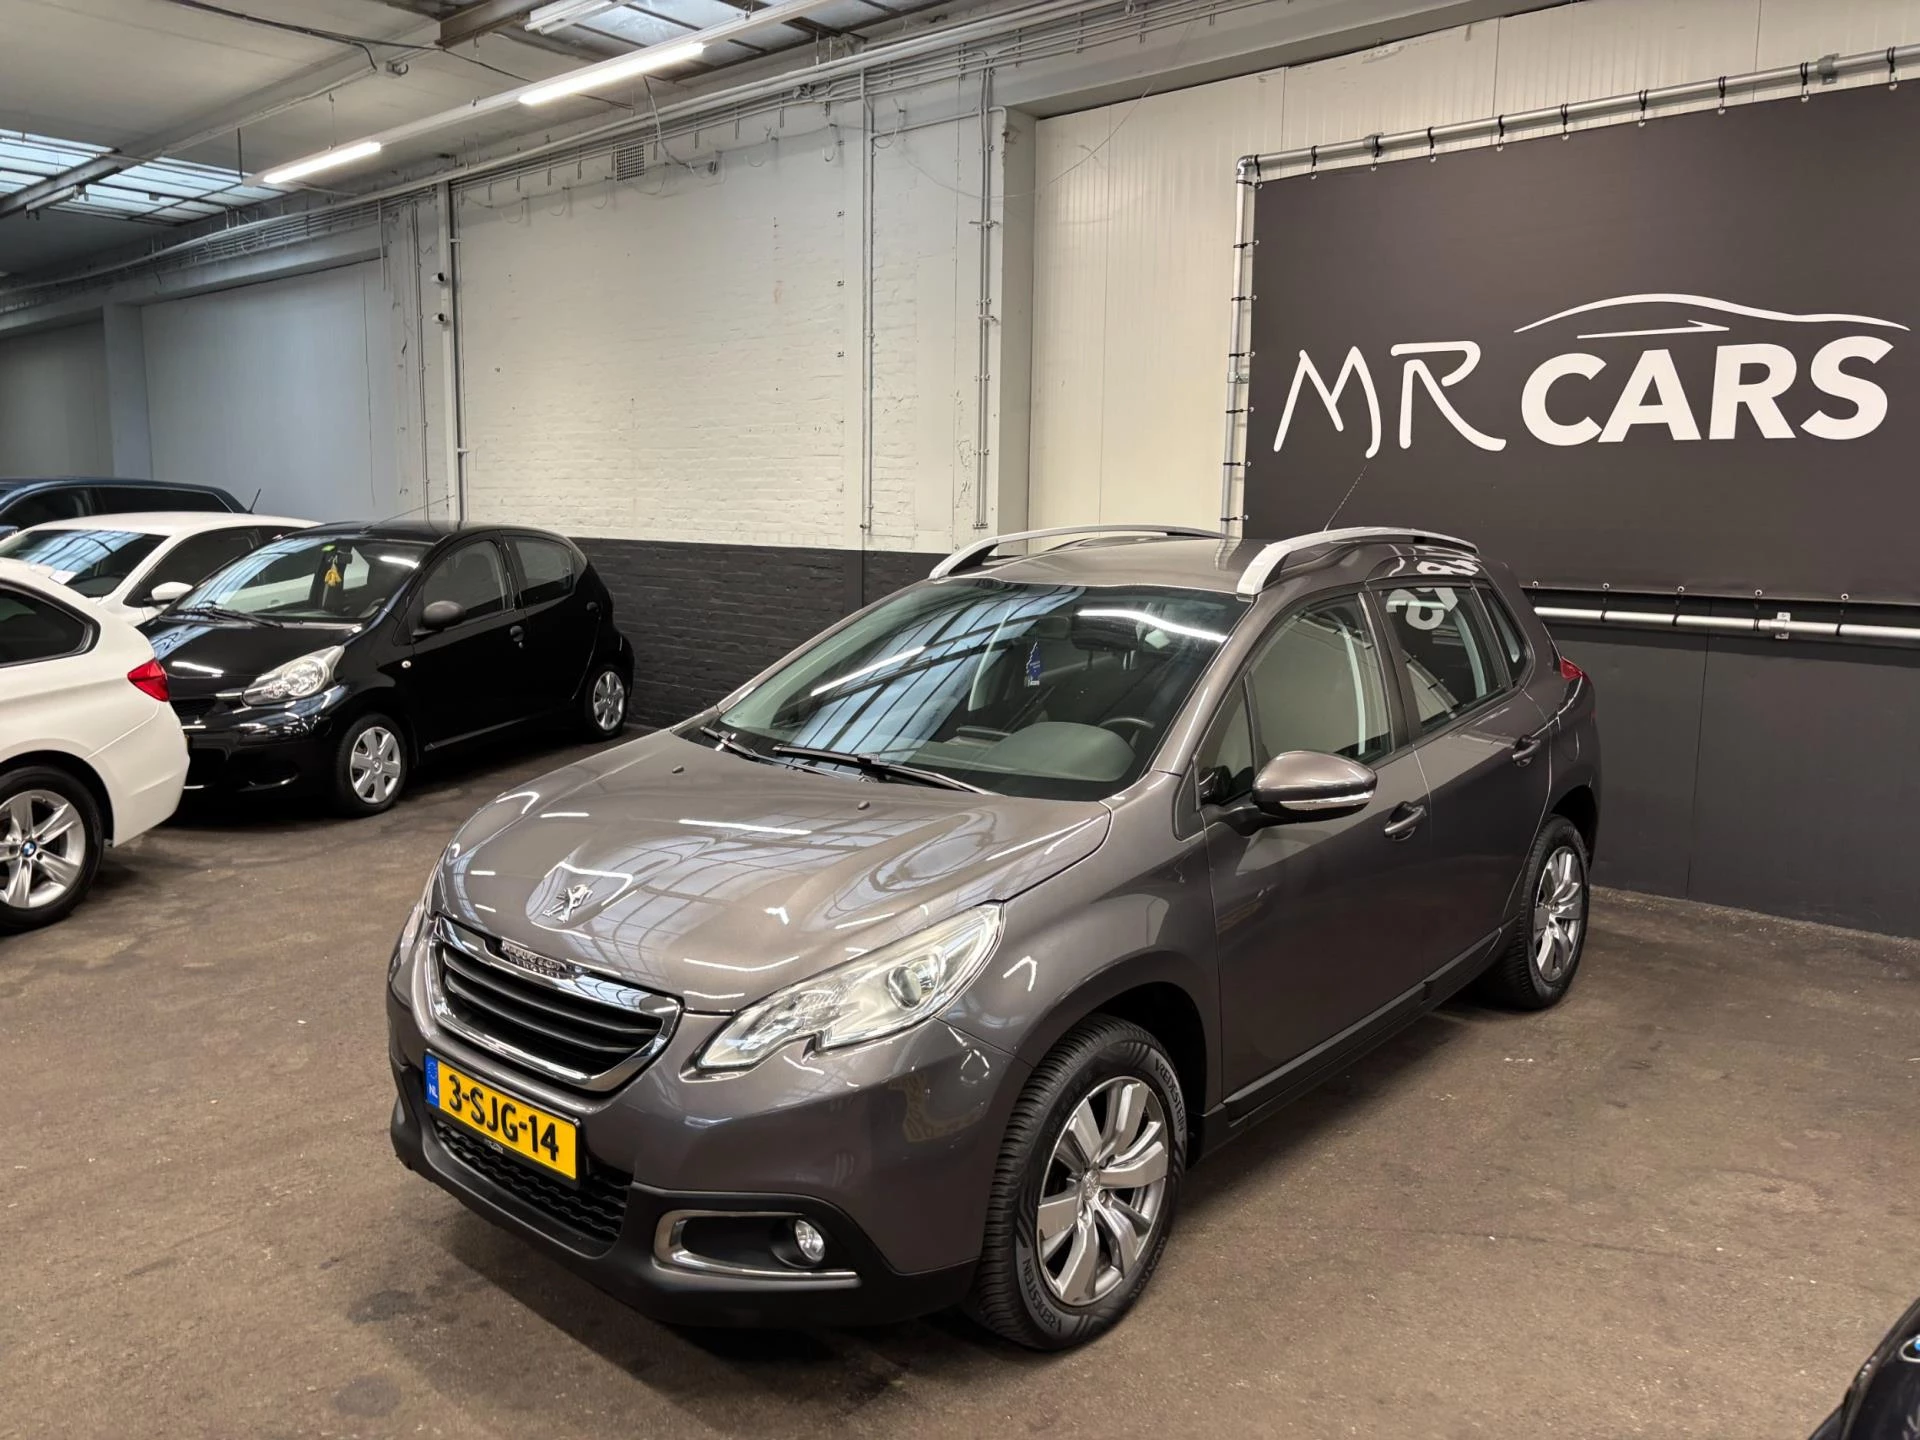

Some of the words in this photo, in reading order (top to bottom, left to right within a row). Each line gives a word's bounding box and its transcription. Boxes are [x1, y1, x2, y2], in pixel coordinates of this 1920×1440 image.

[1273, 340, 1507, 459] MR
[1521, 335, 1894, 447] CARS
[448, 1074, 559, 1162] 3-SJG-14
